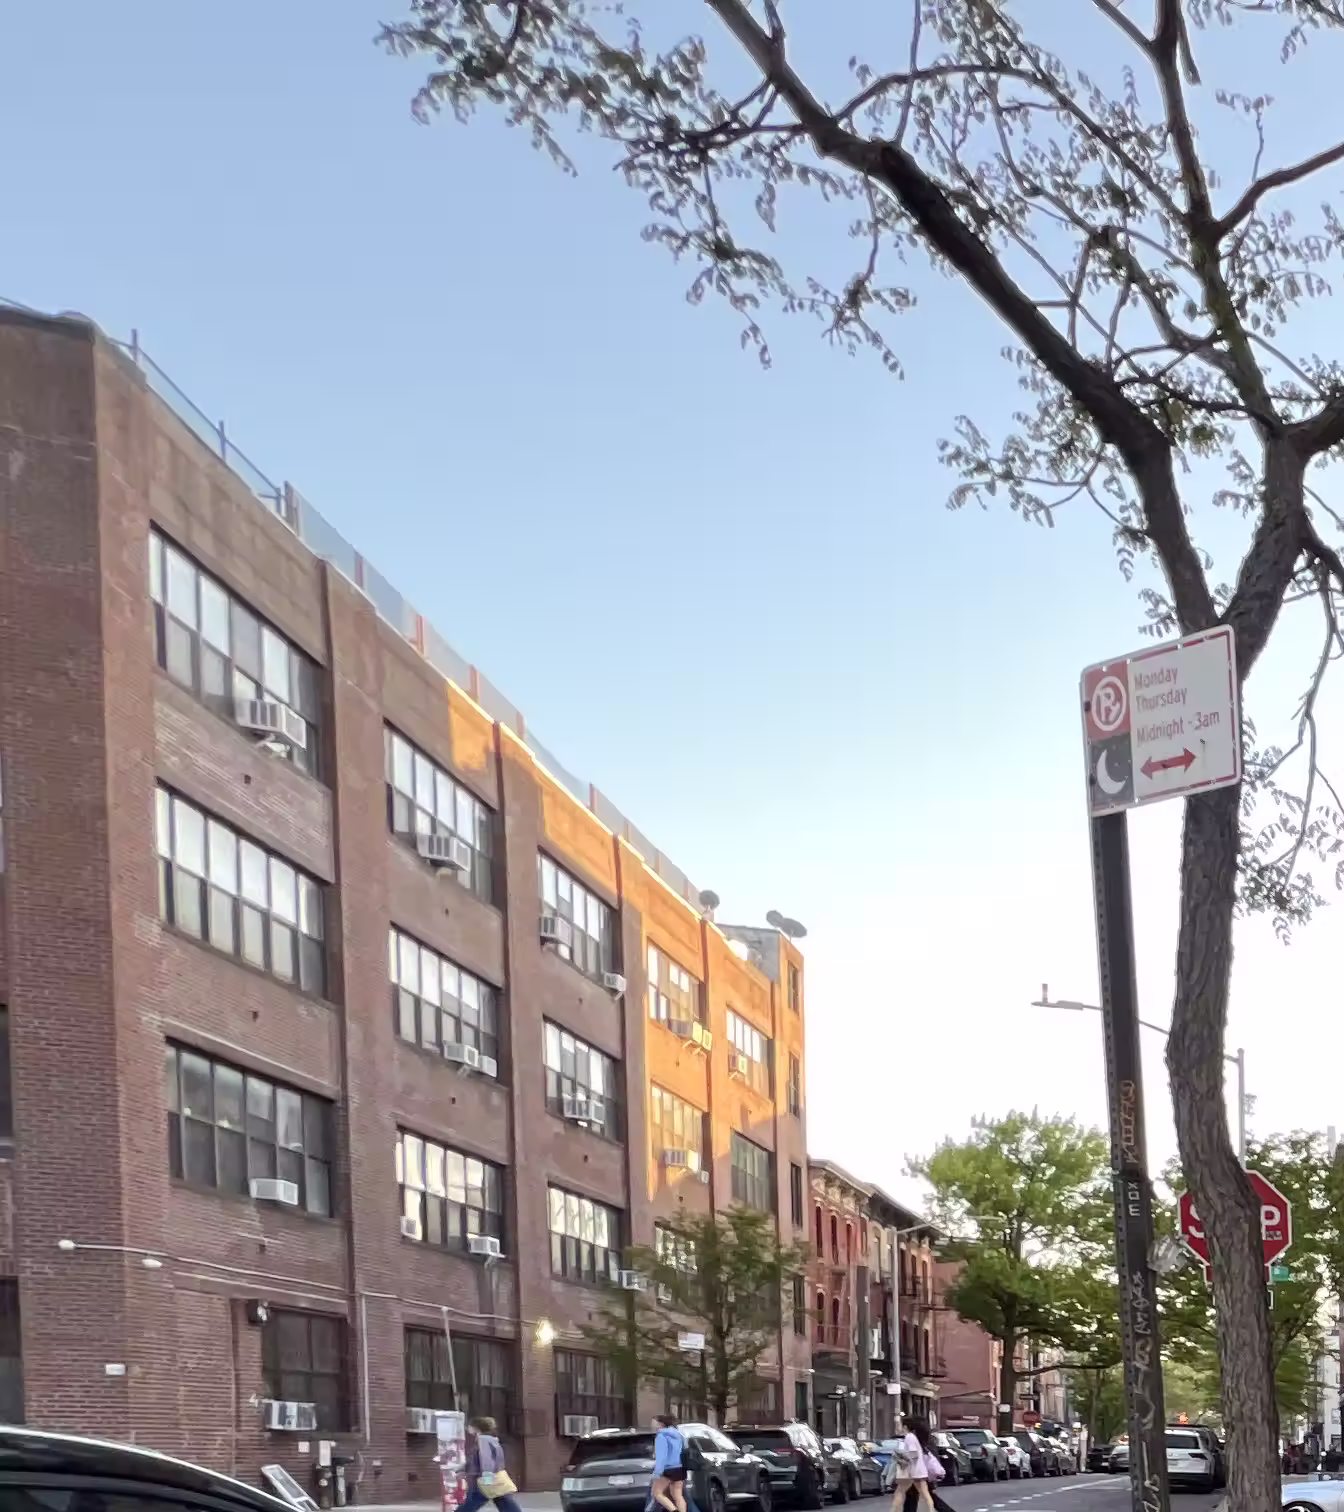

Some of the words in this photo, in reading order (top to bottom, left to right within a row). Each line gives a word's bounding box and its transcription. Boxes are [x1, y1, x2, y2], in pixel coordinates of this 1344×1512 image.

[1134, 667, 1178, 690] Monday
[1135, 688, 1187, 713] Thursday
[1137, 716, 1184, 744] Midnight
[1194, 711, 1220, 732] 3am
